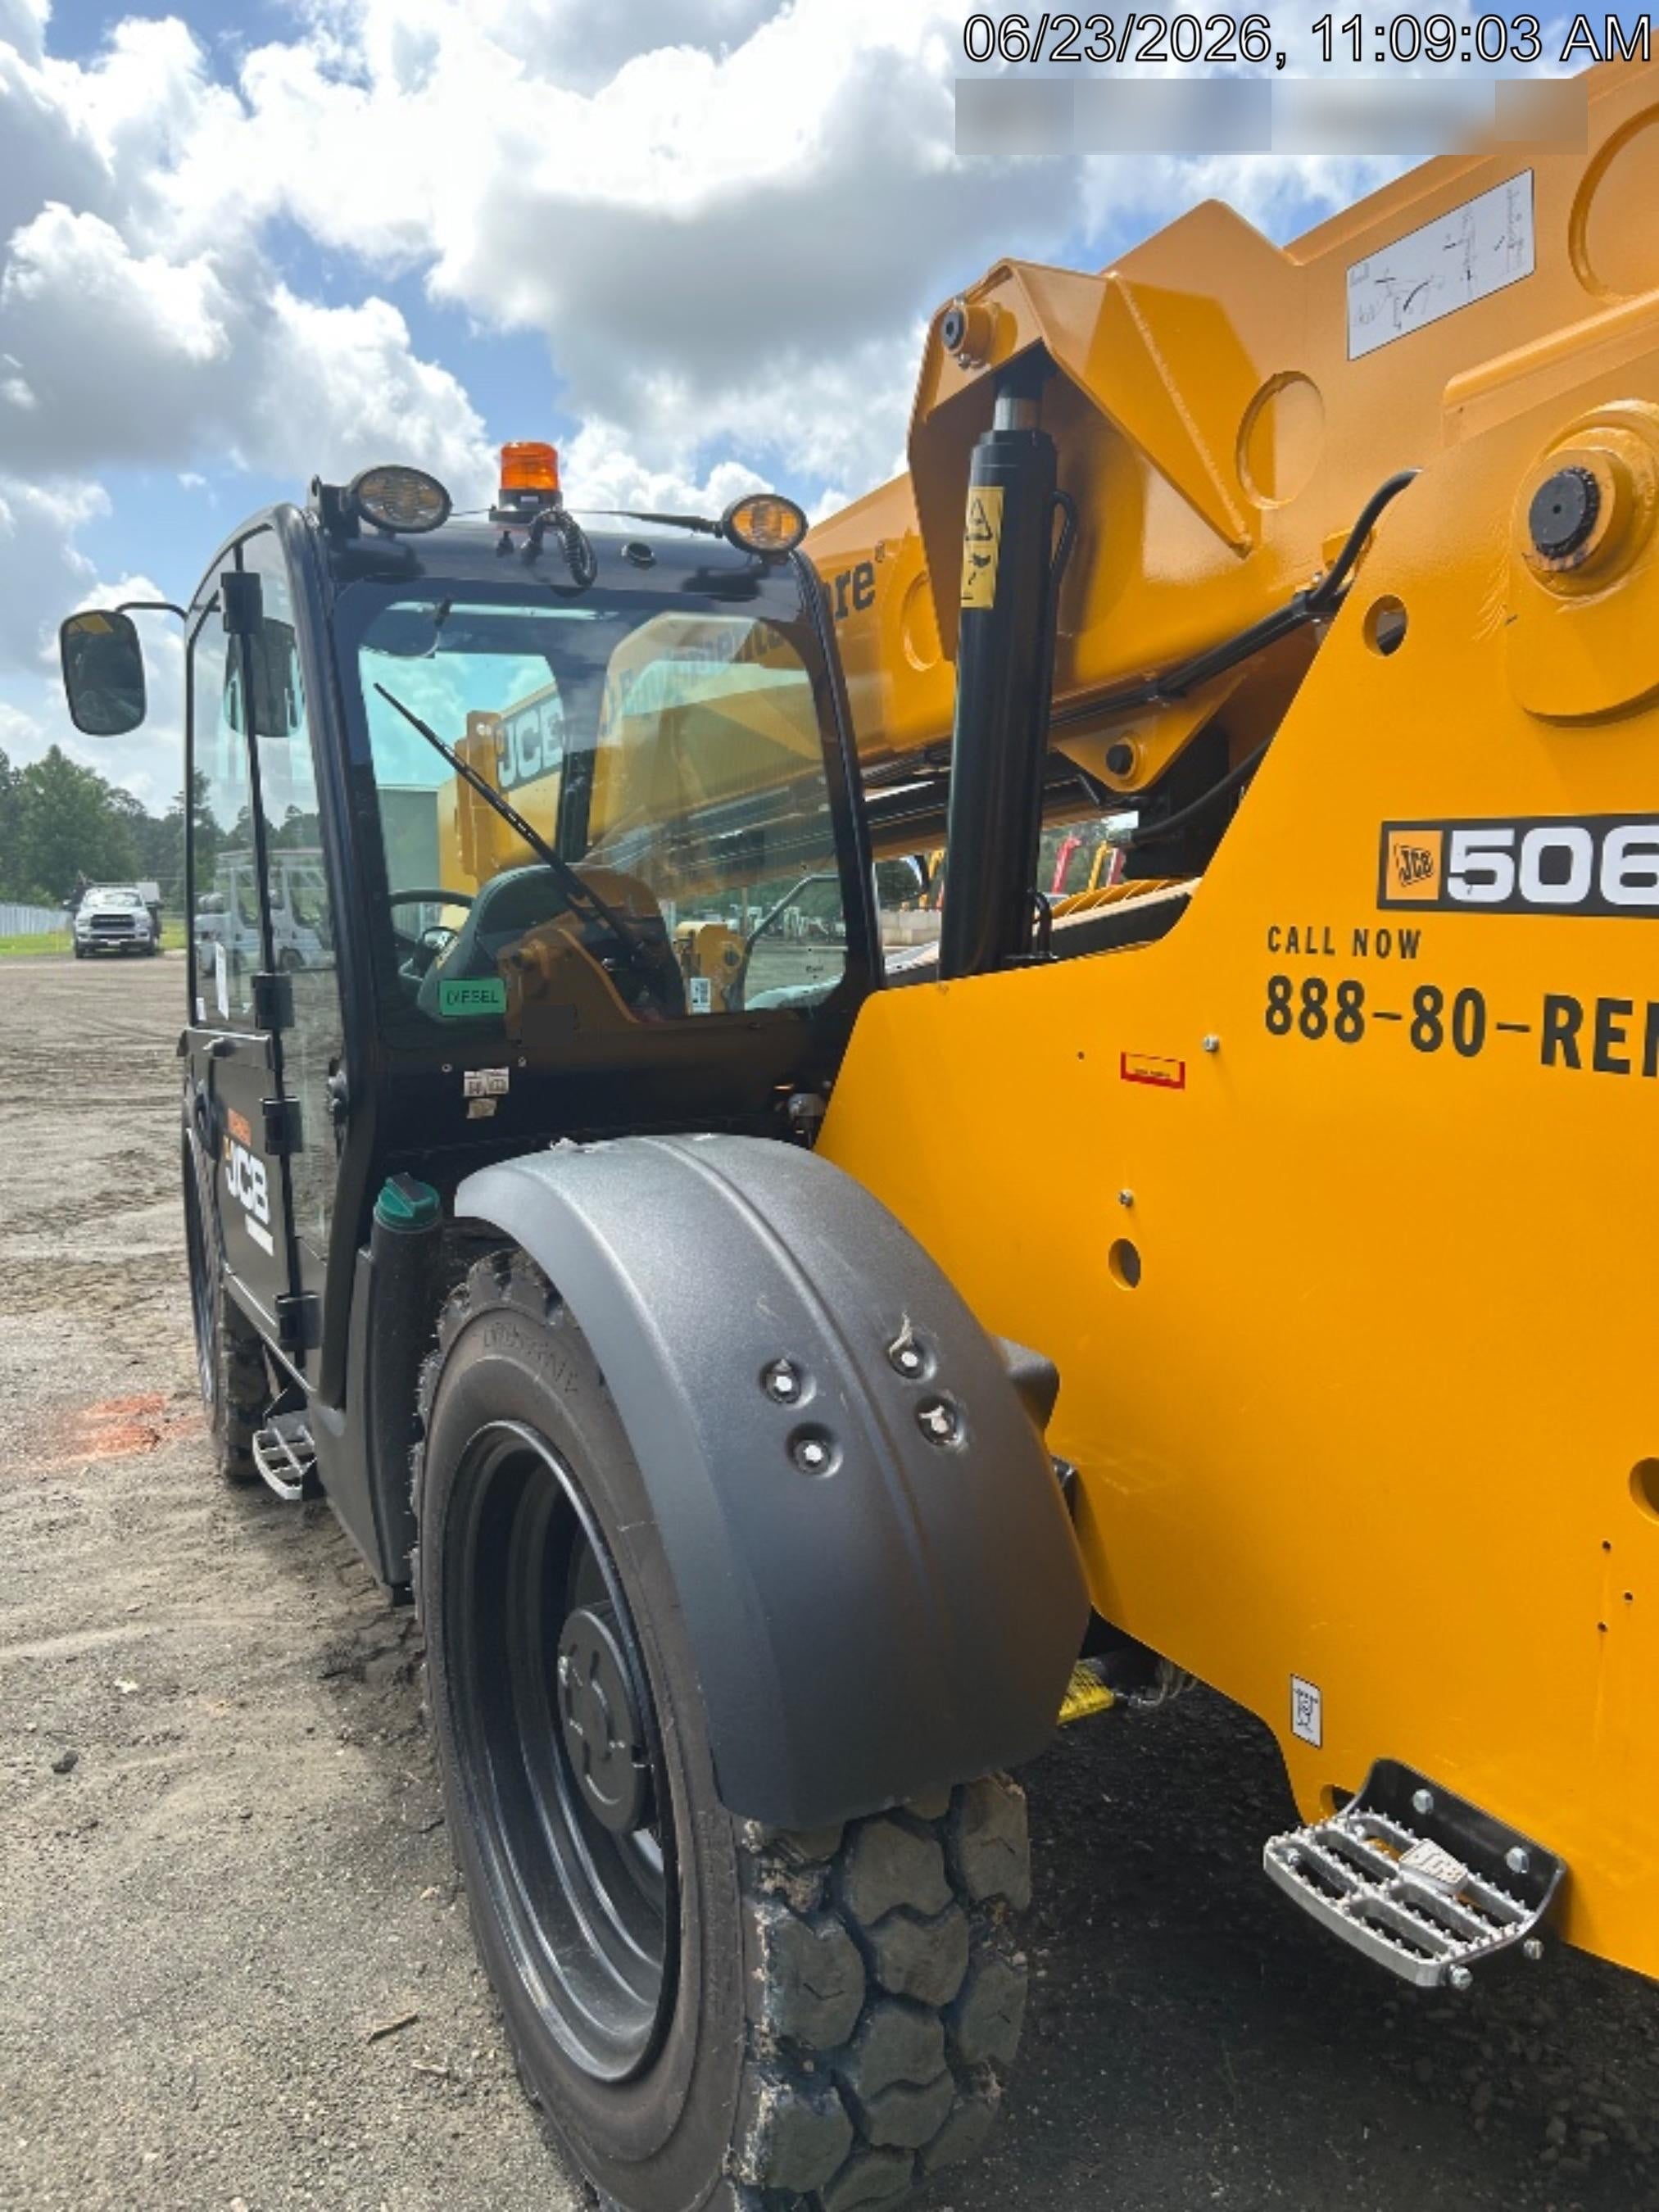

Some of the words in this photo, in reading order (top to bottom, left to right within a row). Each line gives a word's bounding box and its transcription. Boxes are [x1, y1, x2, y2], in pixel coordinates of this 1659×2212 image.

[1446, 824, 1659, 906] 506
[1267, 925, 1336, 955] CALL
[1352, 928, 1421, 959] NOW
[446, 990, 499, 1006] DIESEL
[225, 1139, 270, 1226] JCB
